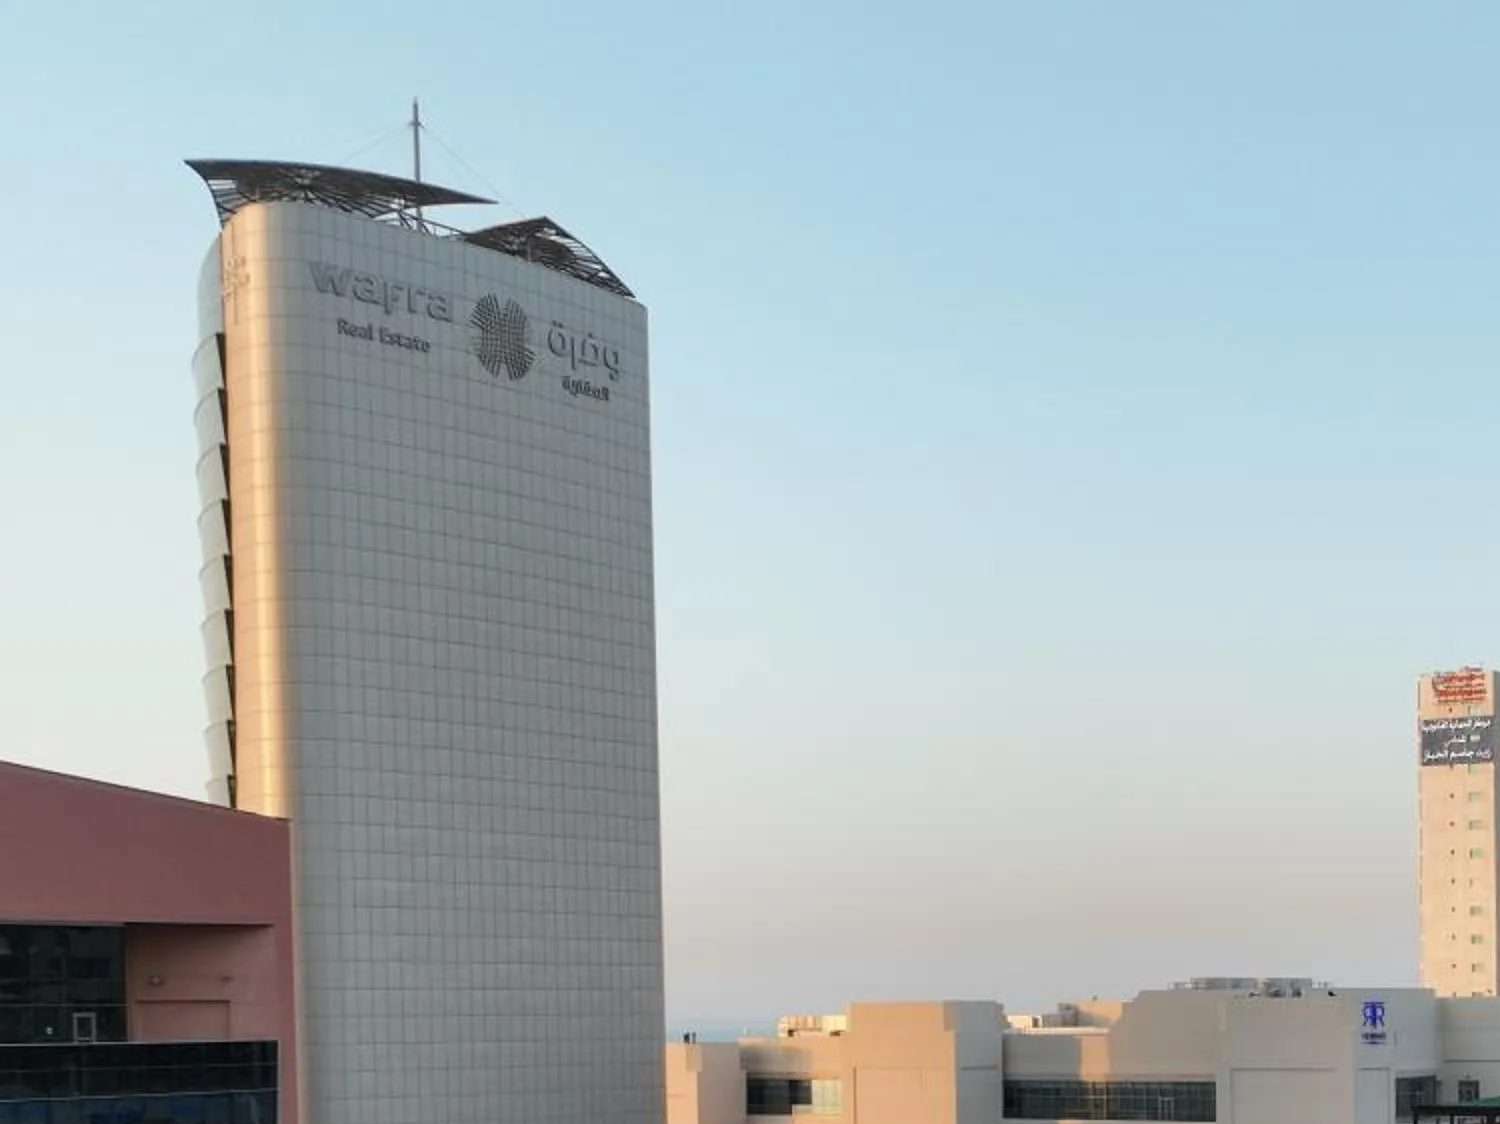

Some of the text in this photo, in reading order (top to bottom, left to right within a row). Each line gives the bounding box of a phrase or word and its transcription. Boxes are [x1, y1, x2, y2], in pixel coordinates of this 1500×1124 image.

[309, 261, 453, 323] wafra
[336, 319, 431, 354] Real Estate
